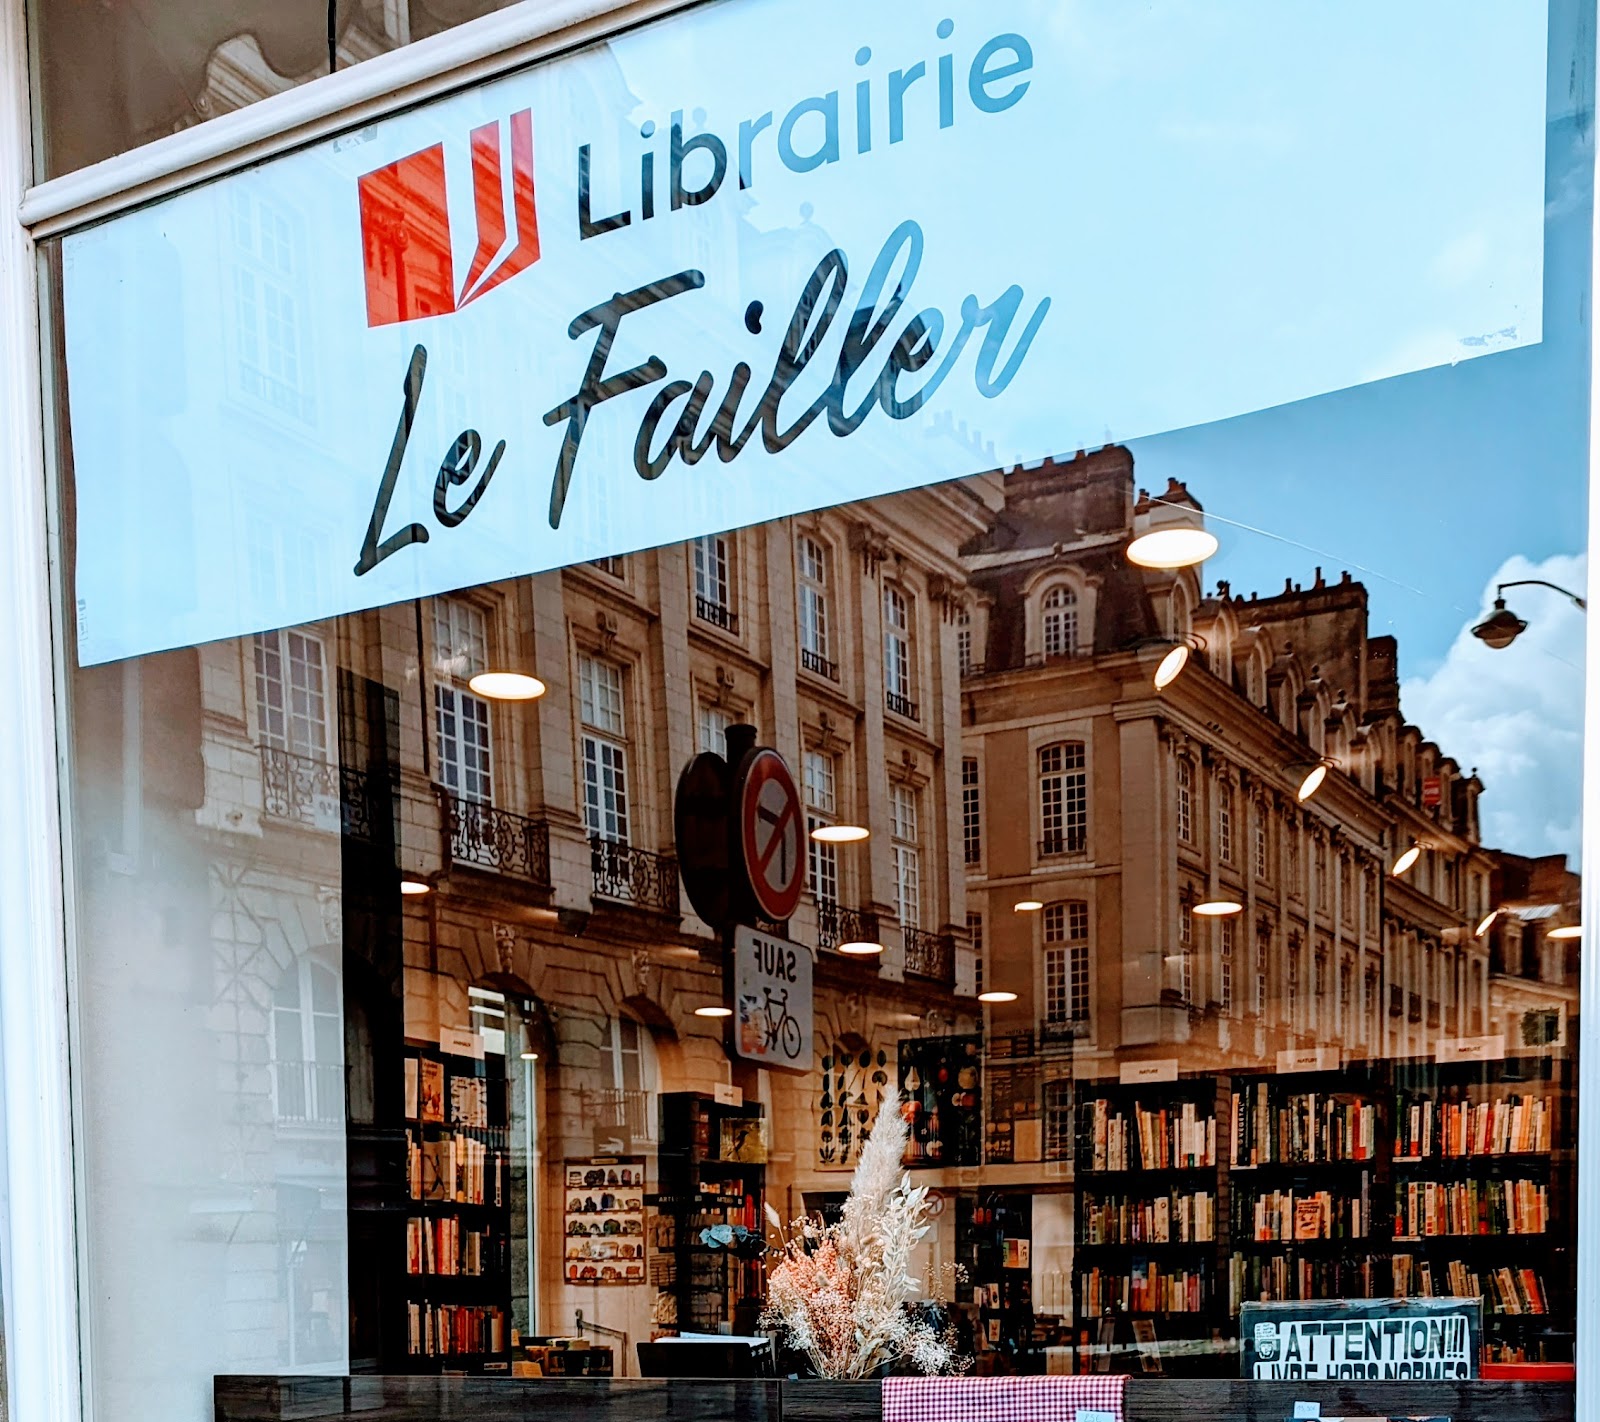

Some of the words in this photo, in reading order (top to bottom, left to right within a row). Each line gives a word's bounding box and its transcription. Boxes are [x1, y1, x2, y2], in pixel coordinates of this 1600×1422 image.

[578, 19, 1034, 241] Librairie
[354, 344, 506, 577] Le
[542, 219, 1052, 530] Failler
[1285, 1318, 1465, 1361] ATTENTION!!!
